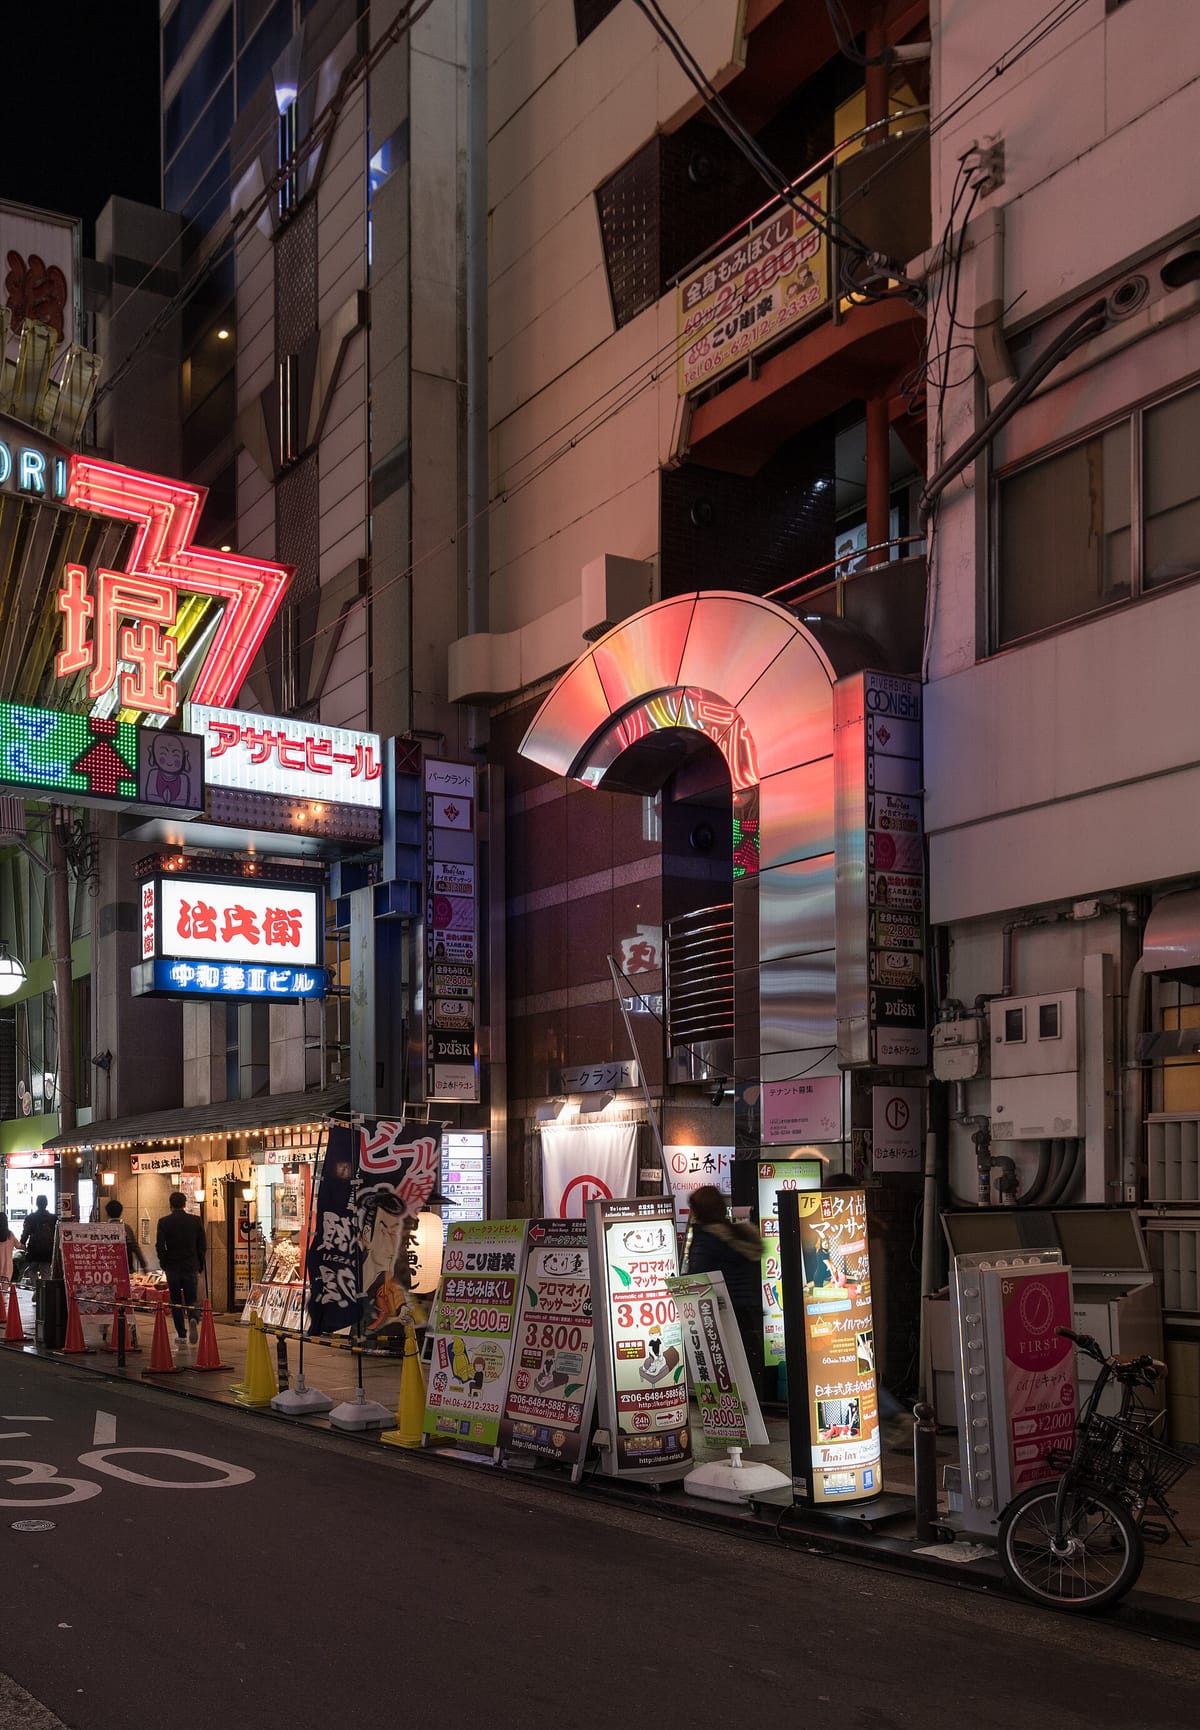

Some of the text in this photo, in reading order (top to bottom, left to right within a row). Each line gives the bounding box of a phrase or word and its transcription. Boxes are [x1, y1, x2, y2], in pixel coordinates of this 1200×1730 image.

[686, 220, 789, 308] 全身もみほぐし
[871, 677, 912, 694] RIVERSIDE
[209, 721, 382, 780] アサヒビール
[429, 773, 471, 786] パークランド
[176, 898, 303, 947] 治兵衛
[885, 1001, 916, 1016] DUSK
[438, 1043, 471, 1056] DUSK
[760, 1165, 772, 1175] 4F
[801, 1196, 816, 1208] 7F
[822, 1200, 832, 1217] 本格
[465, 1252, 516, 1271] こり道楽
[628, 1259, 676, 1275] アロマオイル
[446, 1280, 511, 1299] 全身もみほぐし
[1002, 1280, 1014, 1294] 6F
[539, 1297, 581, 1313] マッサージ
[700, 1302, 730, 1391] 全身もみほぐし
[1019, 1338, 1059, 1354] FIRST
[517, 1395, 567, 1411] 06-6484-5885
[631, 1390, 679, 1402] 06-6484-5885
[1039, 1412, 1072, 1432] ¥2,000
[821, 1448, 842, 1463] Thai
